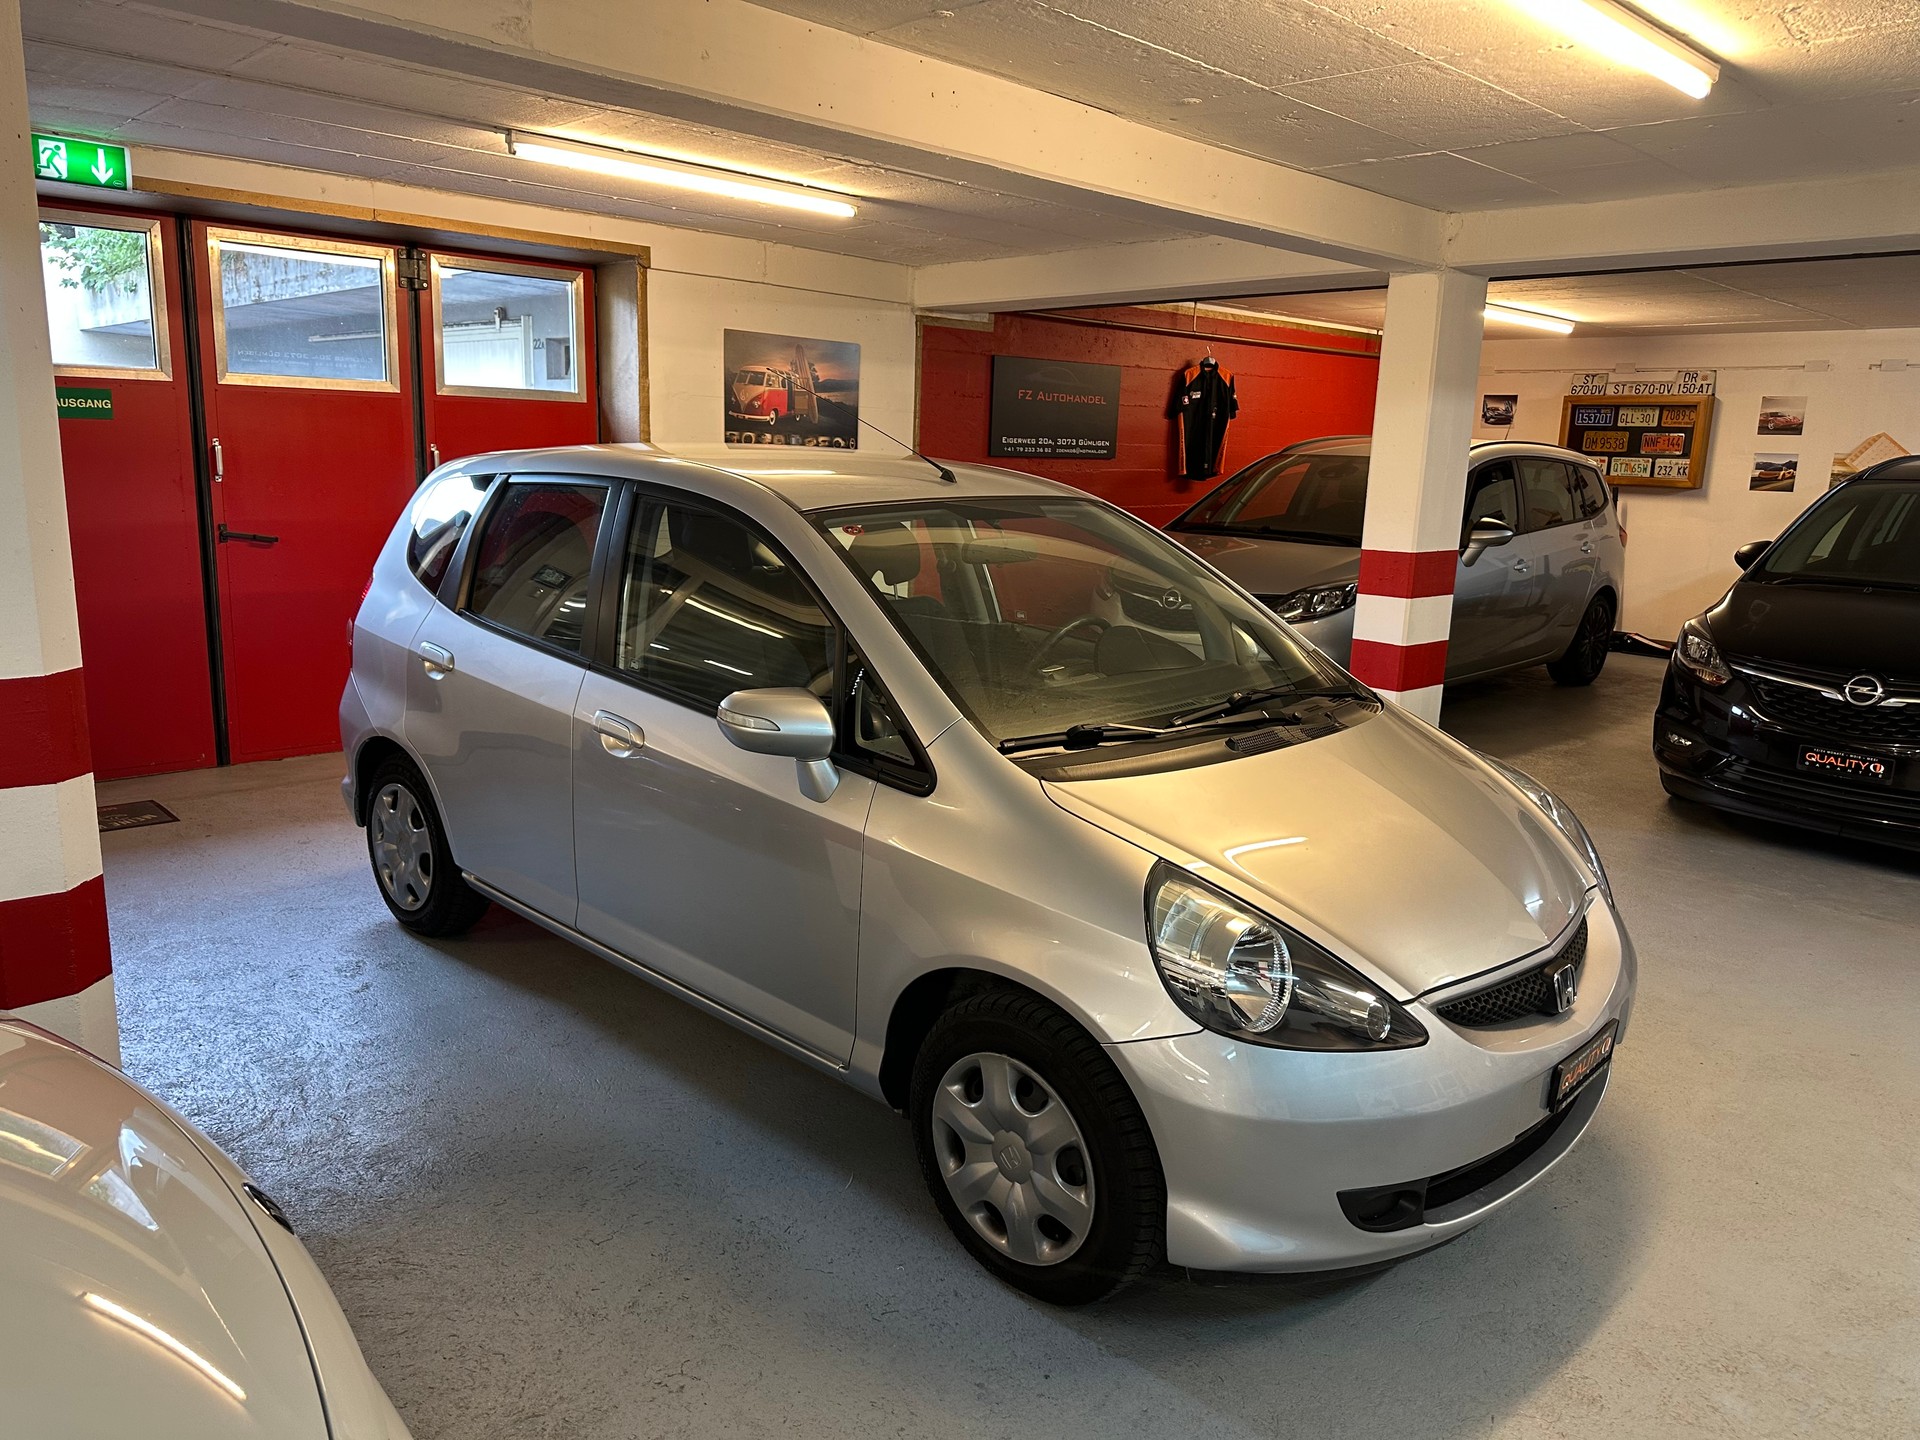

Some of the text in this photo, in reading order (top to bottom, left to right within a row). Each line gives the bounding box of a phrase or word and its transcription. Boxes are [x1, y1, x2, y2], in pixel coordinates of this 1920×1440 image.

[1017, 389, 1033, 401] FZ
[1612, 383, 1628, 395] ST
[1056, 438, 1077, 446] 3073
[1656, 465, 1673, 476] 232
[1805, 752, 1870, 770] QUALITY
[1561, 1045, 1603, 1090] QUALITY
